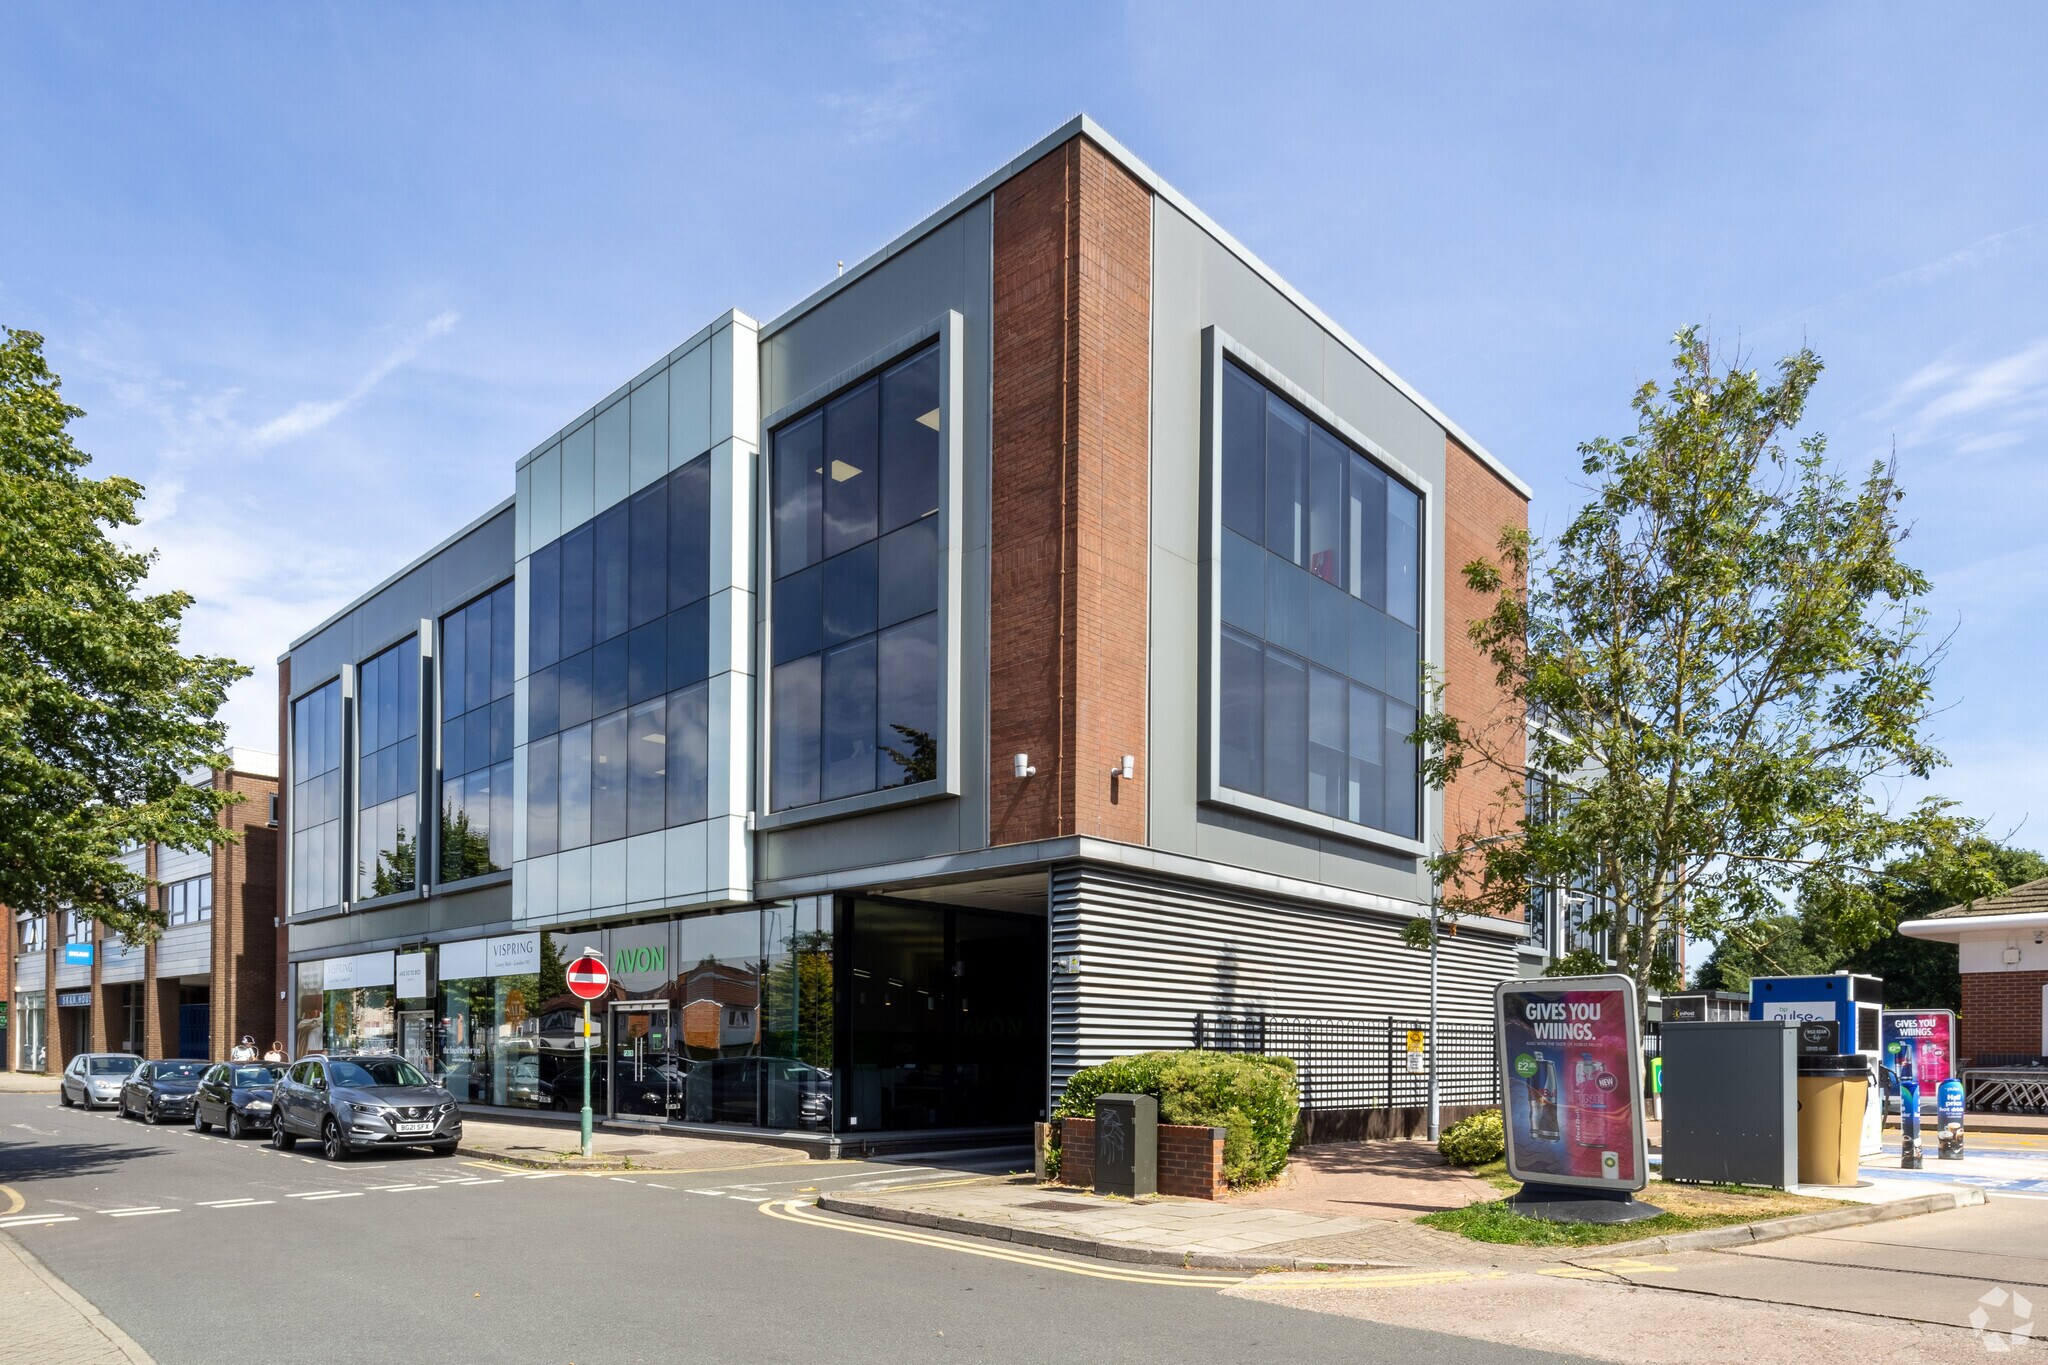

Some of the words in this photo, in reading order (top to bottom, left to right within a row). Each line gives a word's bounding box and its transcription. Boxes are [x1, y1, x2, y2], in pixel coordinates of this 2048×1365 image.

[493, 941, 533, 956] VISPRING
[614, 945, 665, 974] AVON
[62, 996, 76, 1004] SKAN
[1525, 1003, 1567, 1020] GIVES
[1568, 1003, 1601, 1020] YOU
[1895, 1019, 1918, 1028] GIVES
[1919, 1018, 1936, 1028] YOU
[1534, 1022, 1597, 1040] WIIINGS.
[1599, 1078, 1614, 1087] NEW
